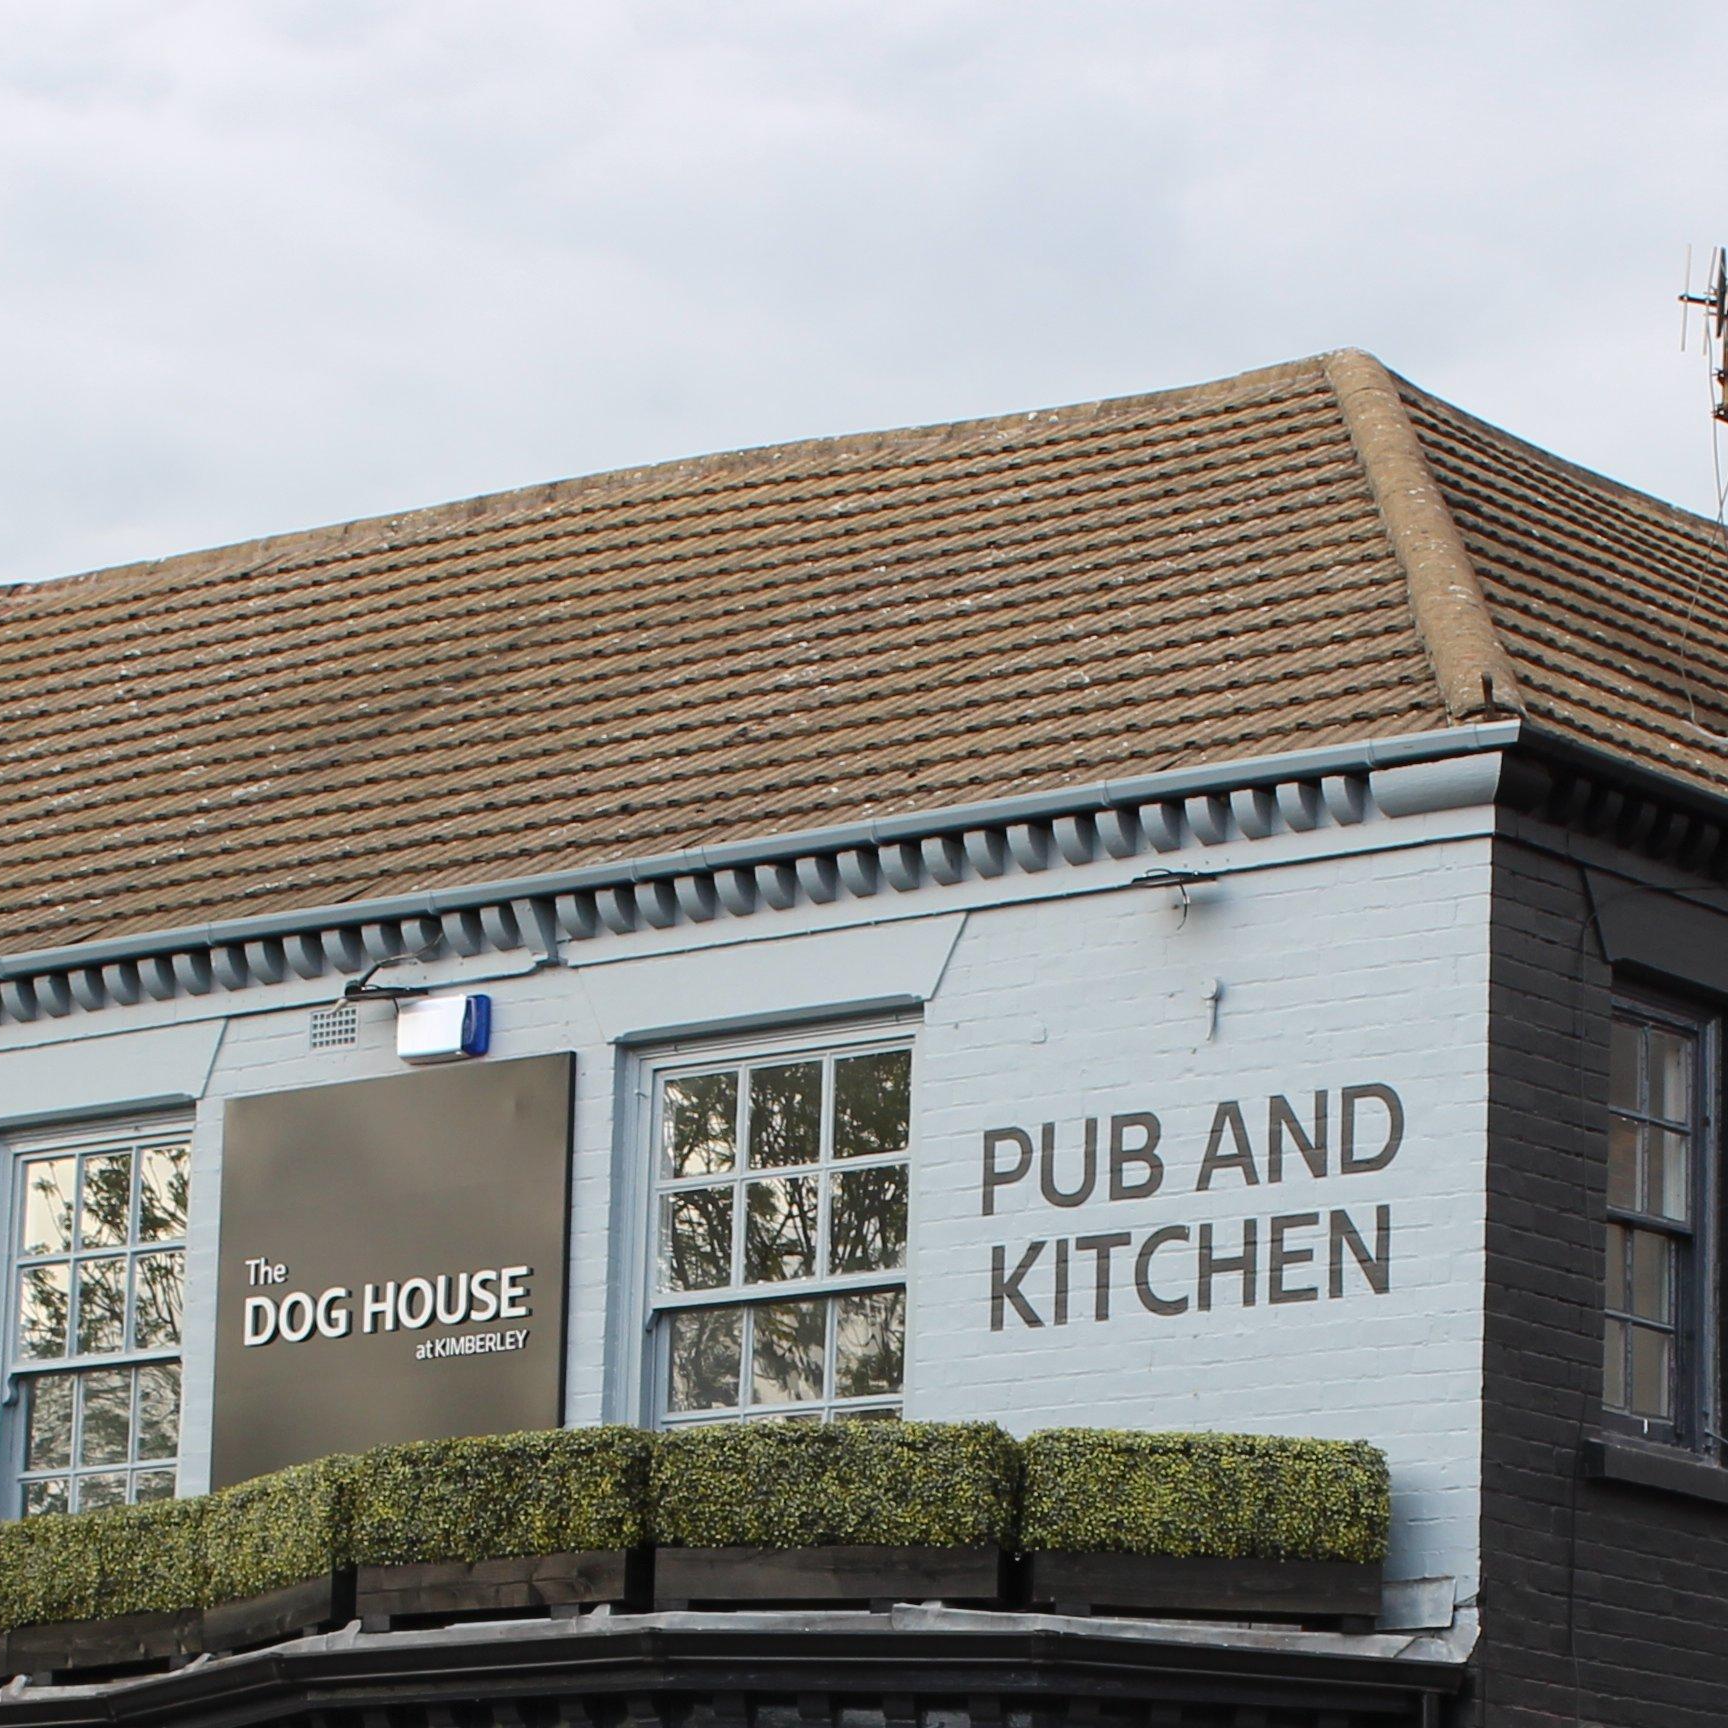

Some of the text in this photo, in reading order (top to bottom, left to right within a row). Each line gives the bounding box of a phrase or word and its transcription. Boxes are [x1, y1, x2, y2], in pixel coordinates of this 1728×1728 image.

[982, 1082, 1405, 1216] PUB AND
[244, 1265, 531, 1347] DOG HOUSE
[245, 1256, 288, 1286] The
[990, 1204, 1391, 1332] KITCHEN
[434, 1328, 529, 1358] KIMBERLEY
